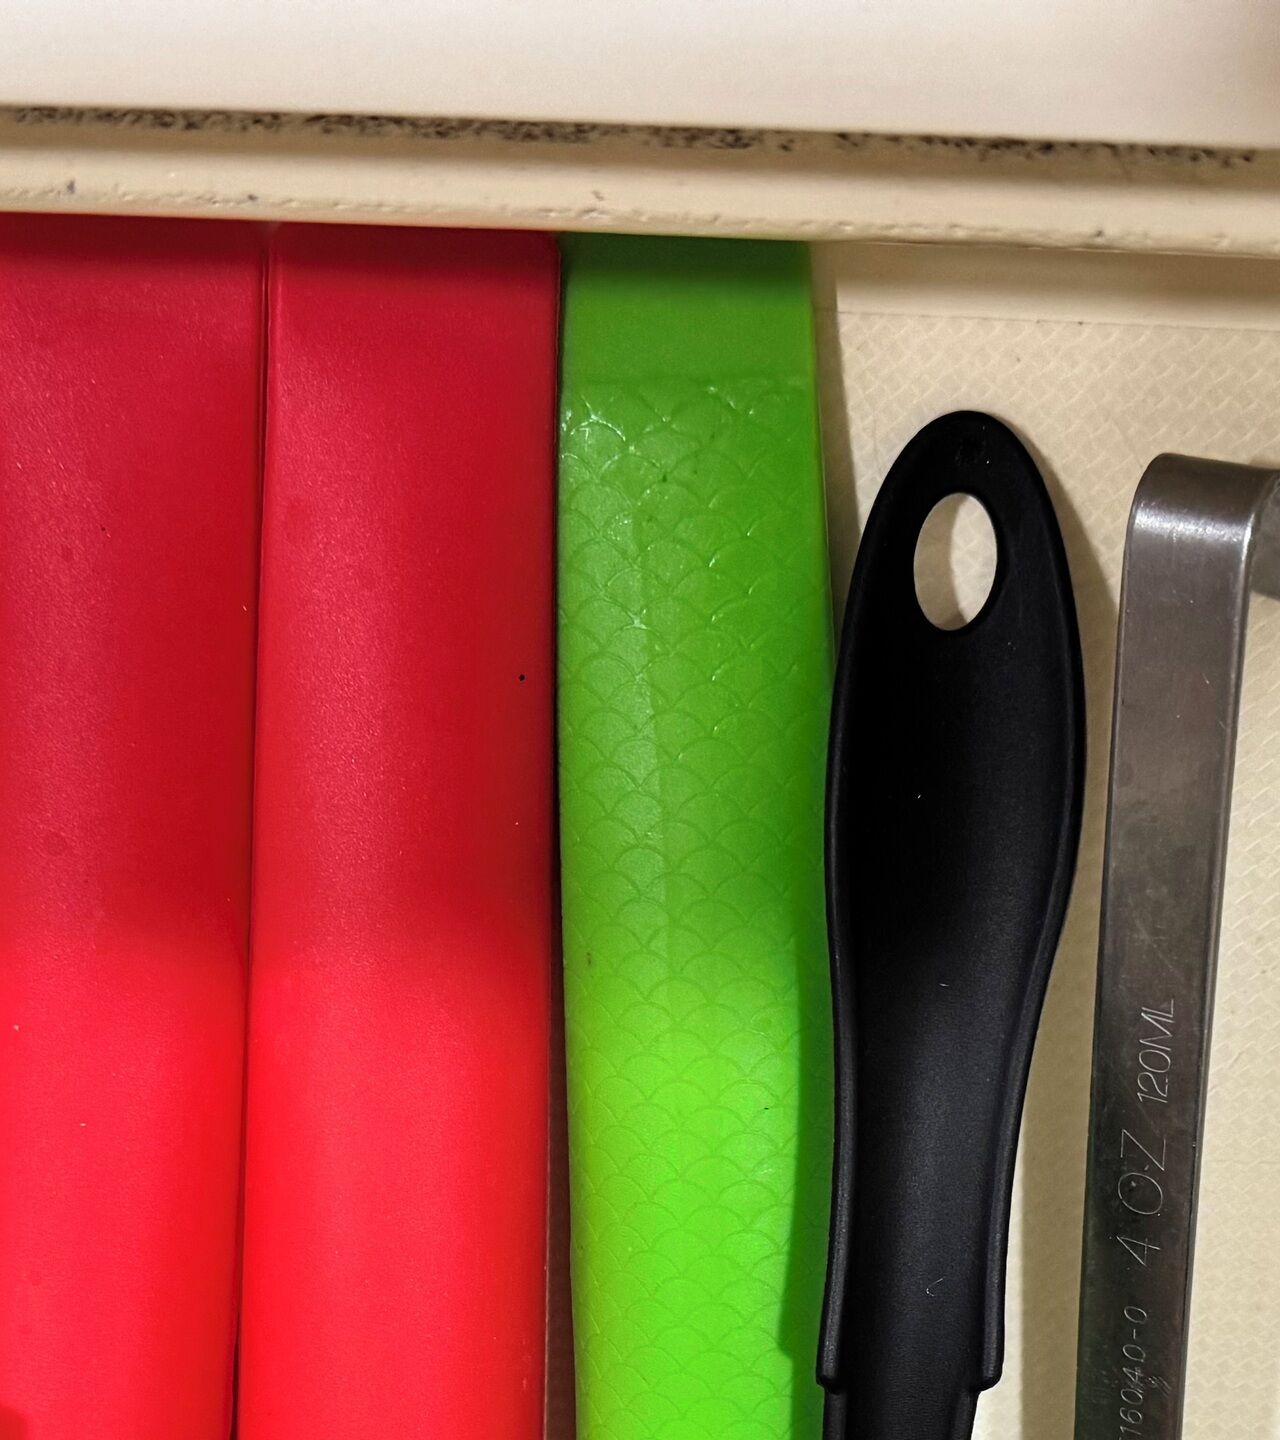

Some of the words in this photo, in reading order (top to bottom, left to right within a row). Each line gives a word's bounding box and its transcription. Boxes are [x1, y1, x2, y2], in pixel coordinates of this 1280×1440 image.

[1135, 998, 1176, 1104] 120ML
[1116, 1127, 1166, 1216] OZ
[1115, 1234, 1162, 1267] 4
